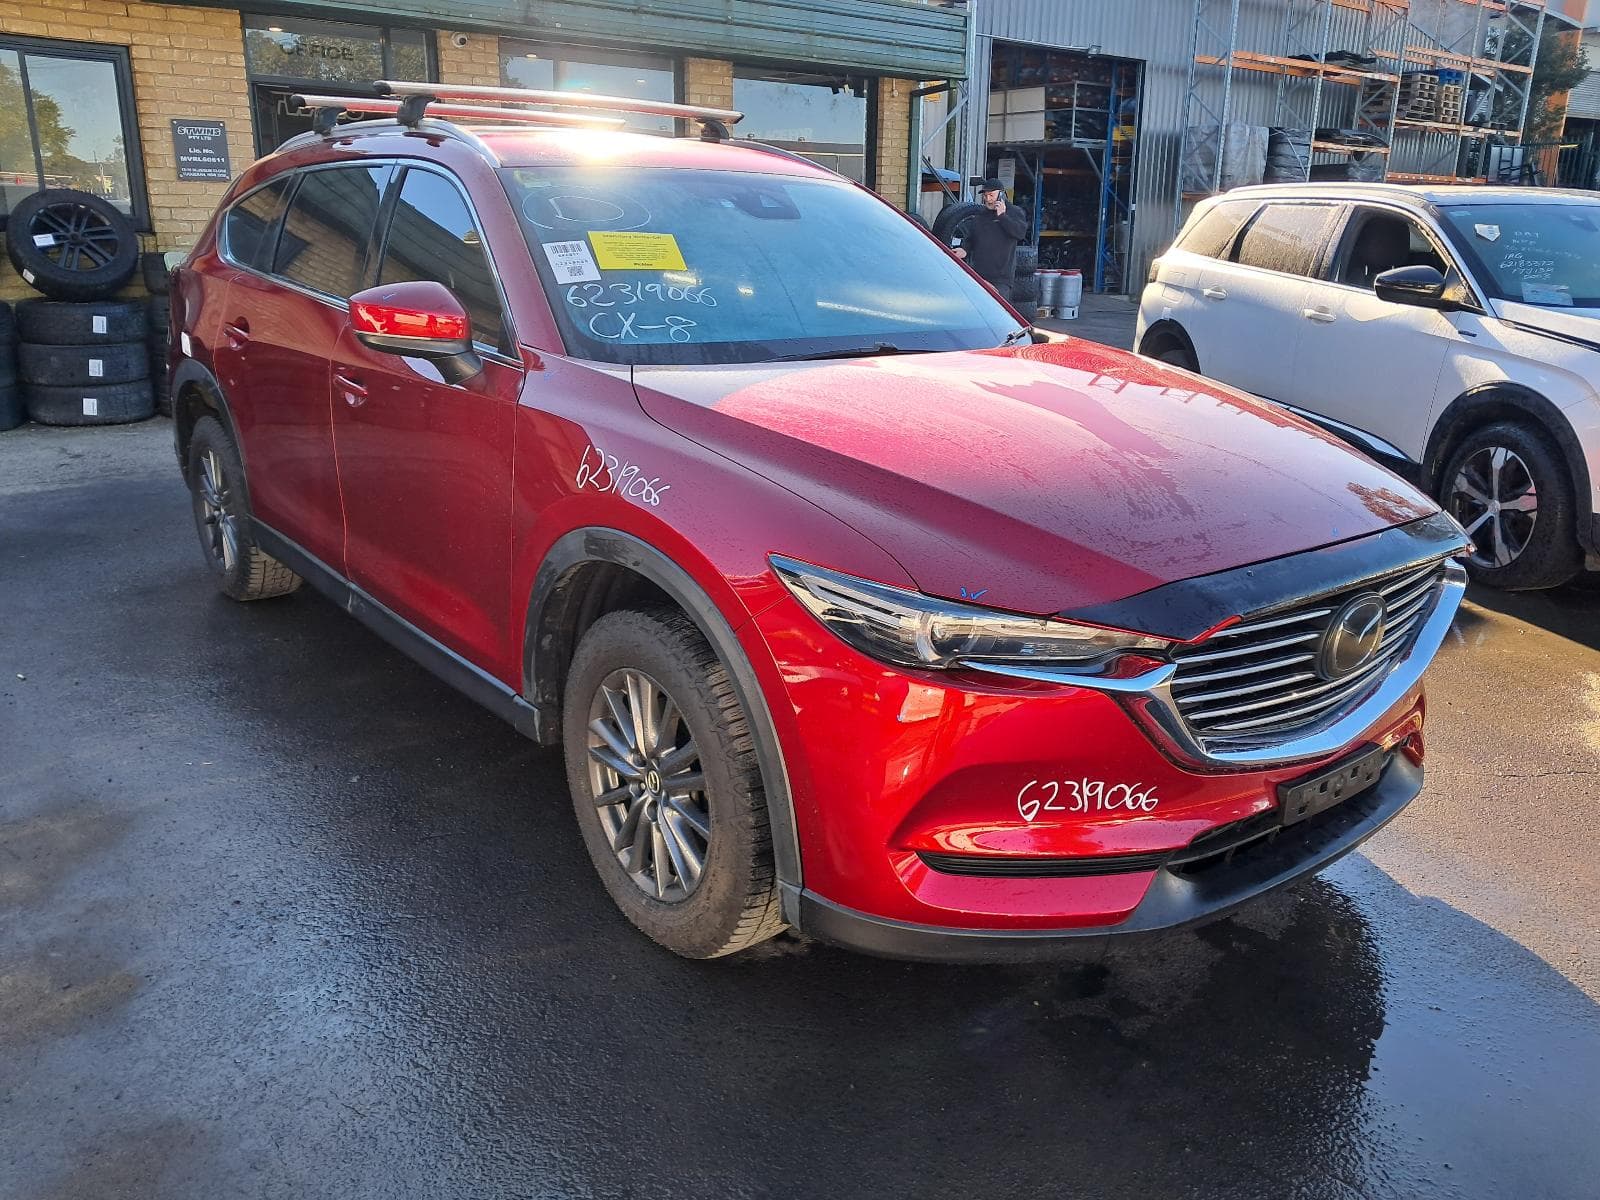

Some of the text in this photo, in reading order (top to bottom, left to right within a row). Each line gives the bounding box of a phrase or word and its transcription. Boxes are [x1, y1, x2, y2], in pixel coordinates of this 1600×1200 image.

[566, 281, 717, 307] 62319066
[589, 312, 697, 343] CX-8
[576, 444, 671, 506] 62319066
[1017, 777, 1159, 822] 62319066
